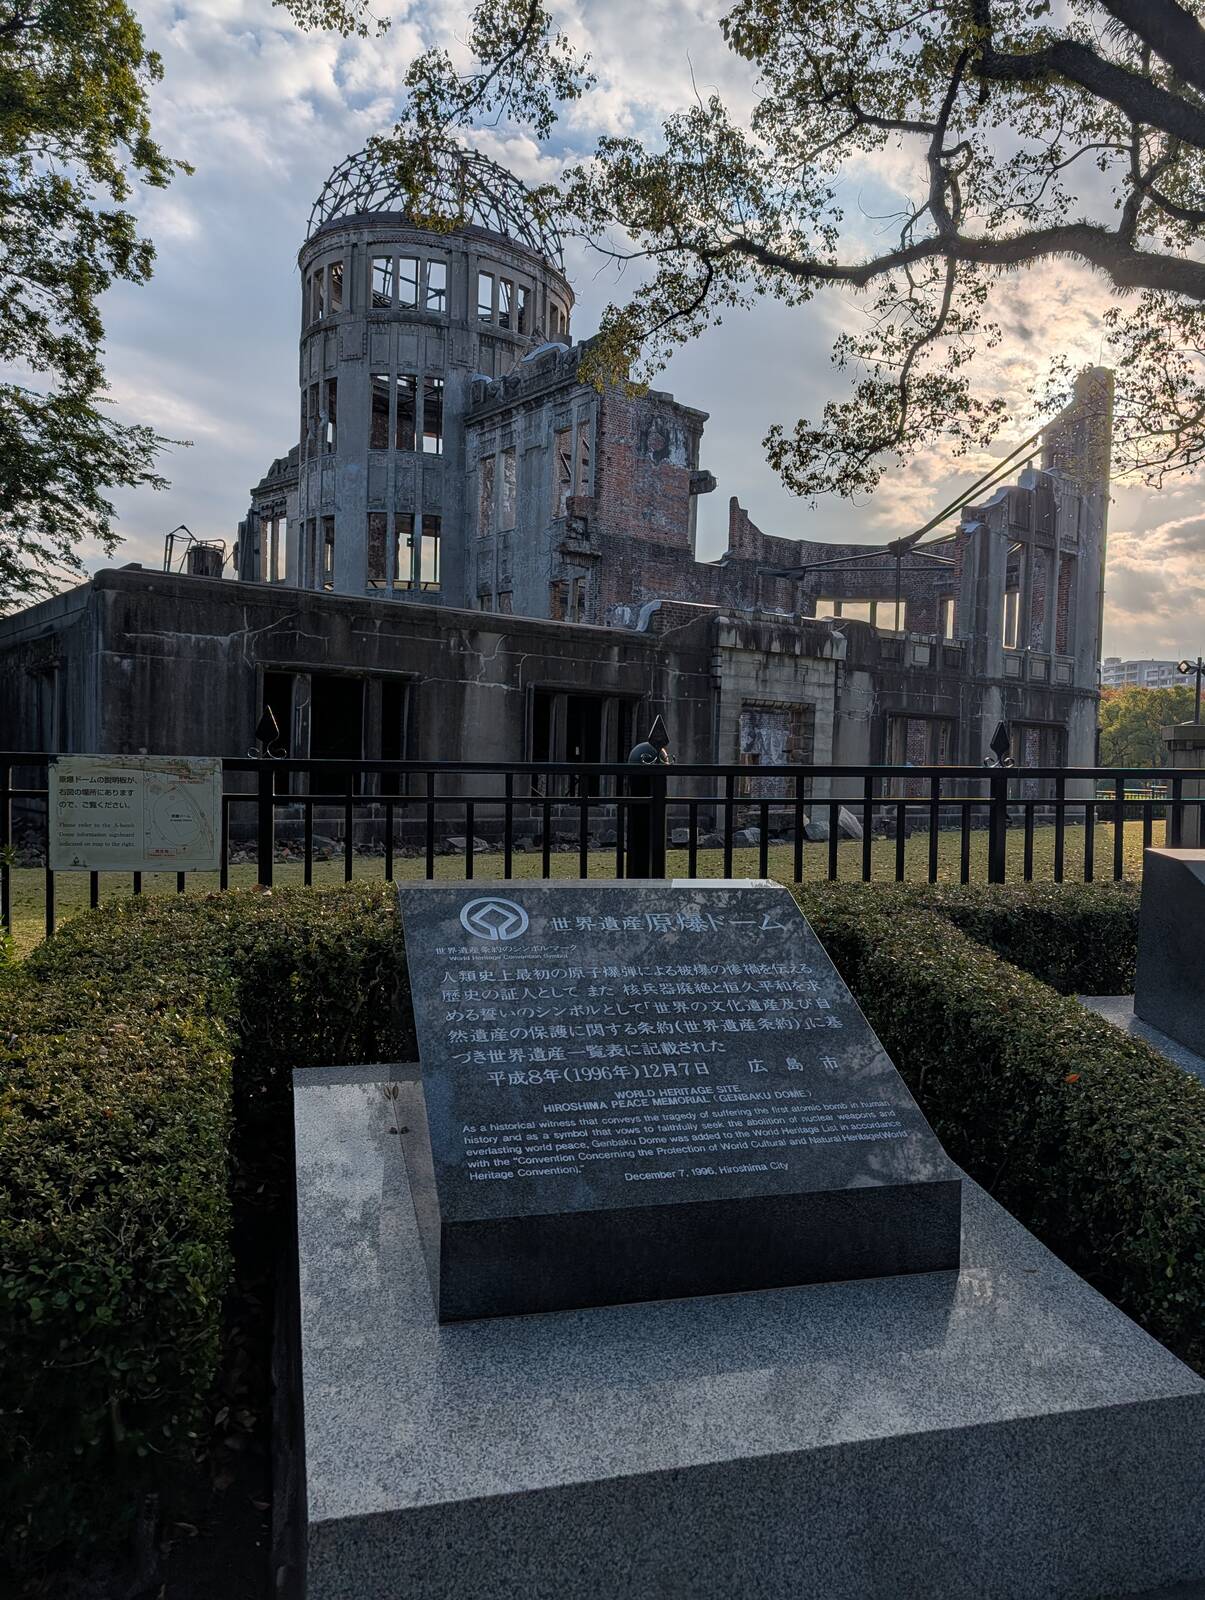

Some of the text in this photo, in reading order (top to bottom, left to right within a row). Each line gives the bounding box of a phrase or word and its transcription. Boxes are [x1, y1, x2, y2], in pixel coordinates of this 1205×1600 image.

[472, 955, 500, 963] Heritage
[543, 1101, 608, 1113] HIROSHIMA
[611, 1098, 650, 1109] PEACE
[653, 1095, 711, 1106] MEMORIAL
[774, 1089, 812, 1100] DOME)
[614, 1084, 741, 1099] WORLD HERITAGE SITE
[462, 1124, 477, 1133] As
[490, 1121, 536, 1131] historical
[538, 1119, 577, 1128] witness
[579, 1117, 598, 1126] that
[601, 1116, 642, 1125] conveys
[644, 1113, 660, 1122] the
[662, 1112, 697, 1121] tragedy
[699, 1110, 709, 1119] of
[712, 1108, 752, 1118] suffering
[754, 1107, 769, 1115] the
[771, 1105, 789, 1113] first
[791, 1103, 822, 1113] atomic
[823, 1102, 849, 1111] bomb
[850, 1101, 859, 1109] in
[861, 1100, 891, 1109] human
[464, 1135, 498, 1145] history
[502, 1134, 522, 1143] and
[526, 1133, 539, 1141] as
[553, 1129, 588, 1140] symbol
[591, 1128, 612, 1136] that
[615, 1127, 641, 1135] vows
[643, 1125, 654, 1133] to
[657, 1122, 698, 1132] faithfully
[701, 1120, 725, 1129] seek
[727, 1119, 743, 1127] the
[746, 1116, 786, 1126] abolition
[788, 1115, 798, 1123] of
[801, 1114, 834, 1123] nuclear
[837, 1111, 877, 1121] weapons
[879, 1109, 896, 1118] and
[466, 1146, 523, 1157] everlasting
[524, 1143, 553, 1153] world
[591, 1138, 637, 1148] Genbaku
[639, 1136, 667, 1145] Dome
[669, 1135, 690, 1143] was
[691, 1132, 721, 1141] added
[722, 1131, 733, 1139] to
[735, 1130, 751, 1138] the
[752, 1128, 780, 1137] World
[781, 1125, 820, 1136] Heritage
[821, 1124, 839, 1133] List
[840, 1123, 849, 1131] in
[850, 1120, 902, 1130] accordance
[467, 1160, 490, 1169] with
[493, 1158, 510, 1167] the
[578, 1149, 636, 1161] Concerning
[637, 1148, 654, 1157] the
[656, 1145, 706, 1155] Protection
[708, 1143, 718, 1151] of
[720, 1141, 749, 1150] World
[750, 1138, 787, 1148] Cultural
[789, 1137, 808, 1146] and
[809, 1134, 842, 1144] Natural
[469, 1170, 514, 1181] Heritage
[624, 1169, 676, 1182] December
[719, 1163, 768, 1174] Hiroshima
[769, 1161, 790, 1171] City
